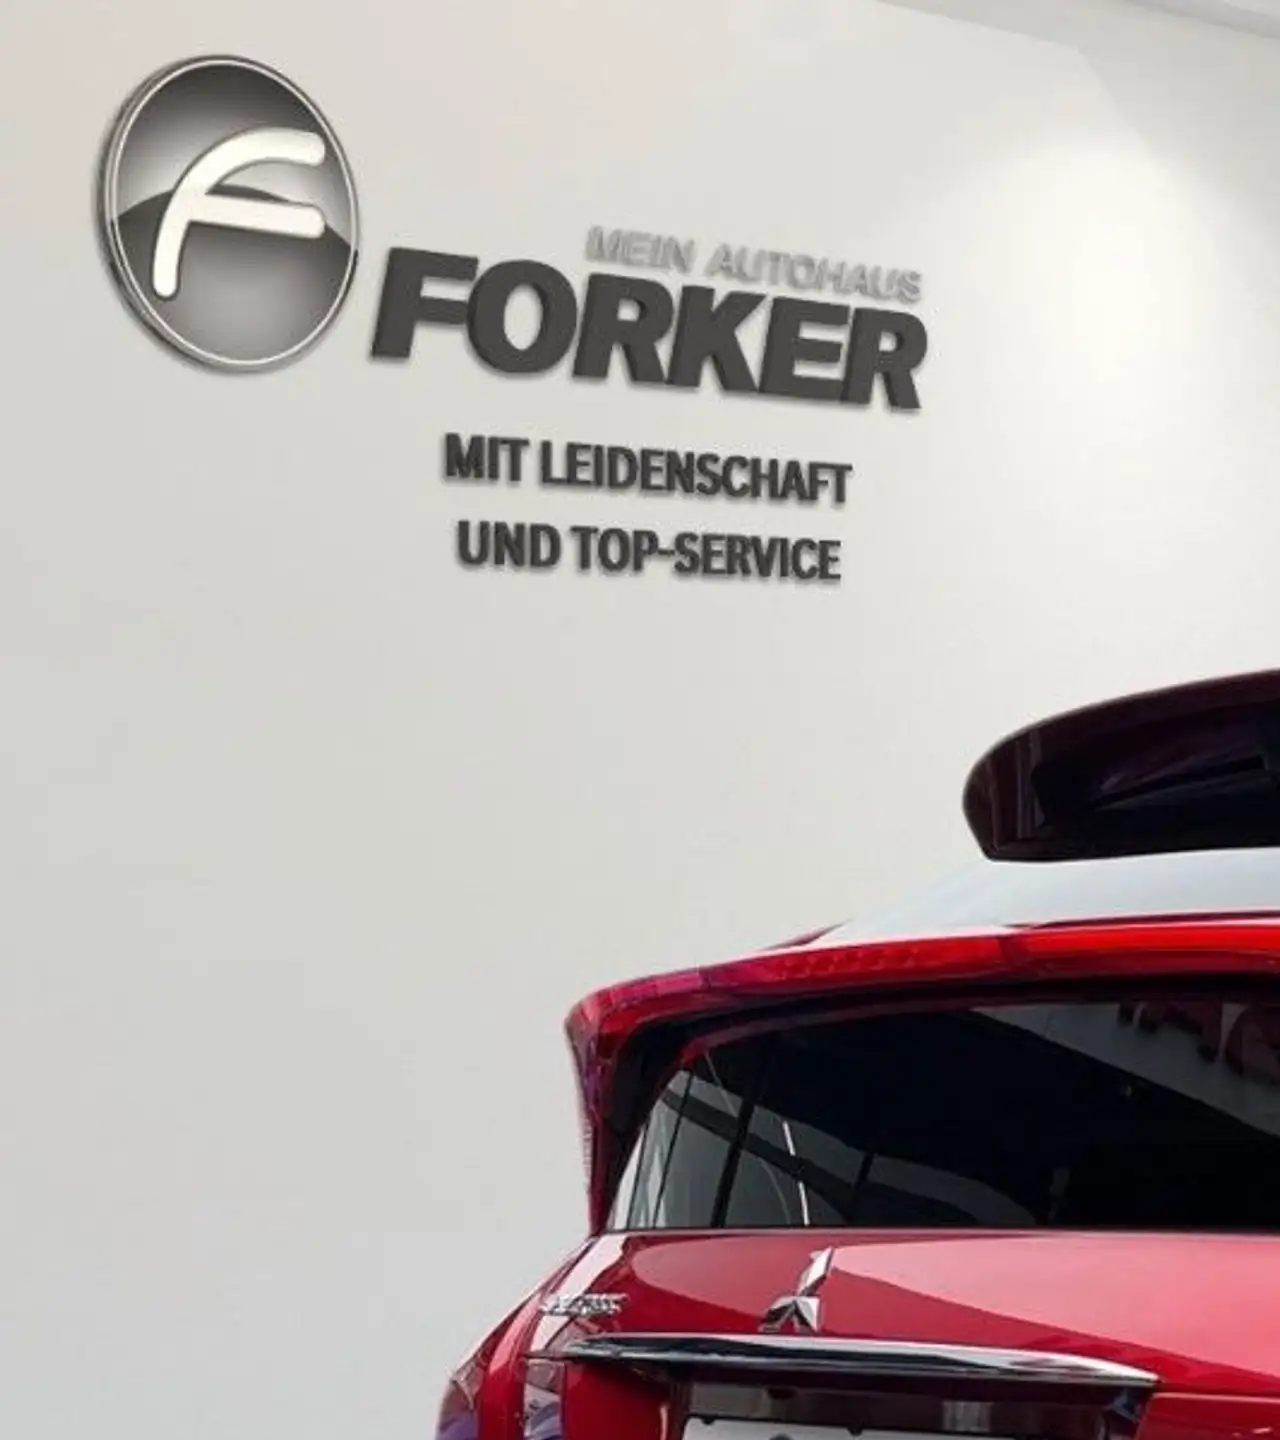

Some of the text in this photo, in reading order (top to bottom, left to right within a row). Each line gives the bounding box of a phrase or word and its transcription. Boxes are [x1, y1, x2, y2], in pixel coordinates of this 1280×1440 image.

[585, 225, 922, 303] MEIN AUTOHAUS
[369, 246, 928, 411] FORKER
[444, 433, 853, 503] MIT LEIDENSCHAFT
[457, 520, 842, 580] UND TOP-SERVICE
